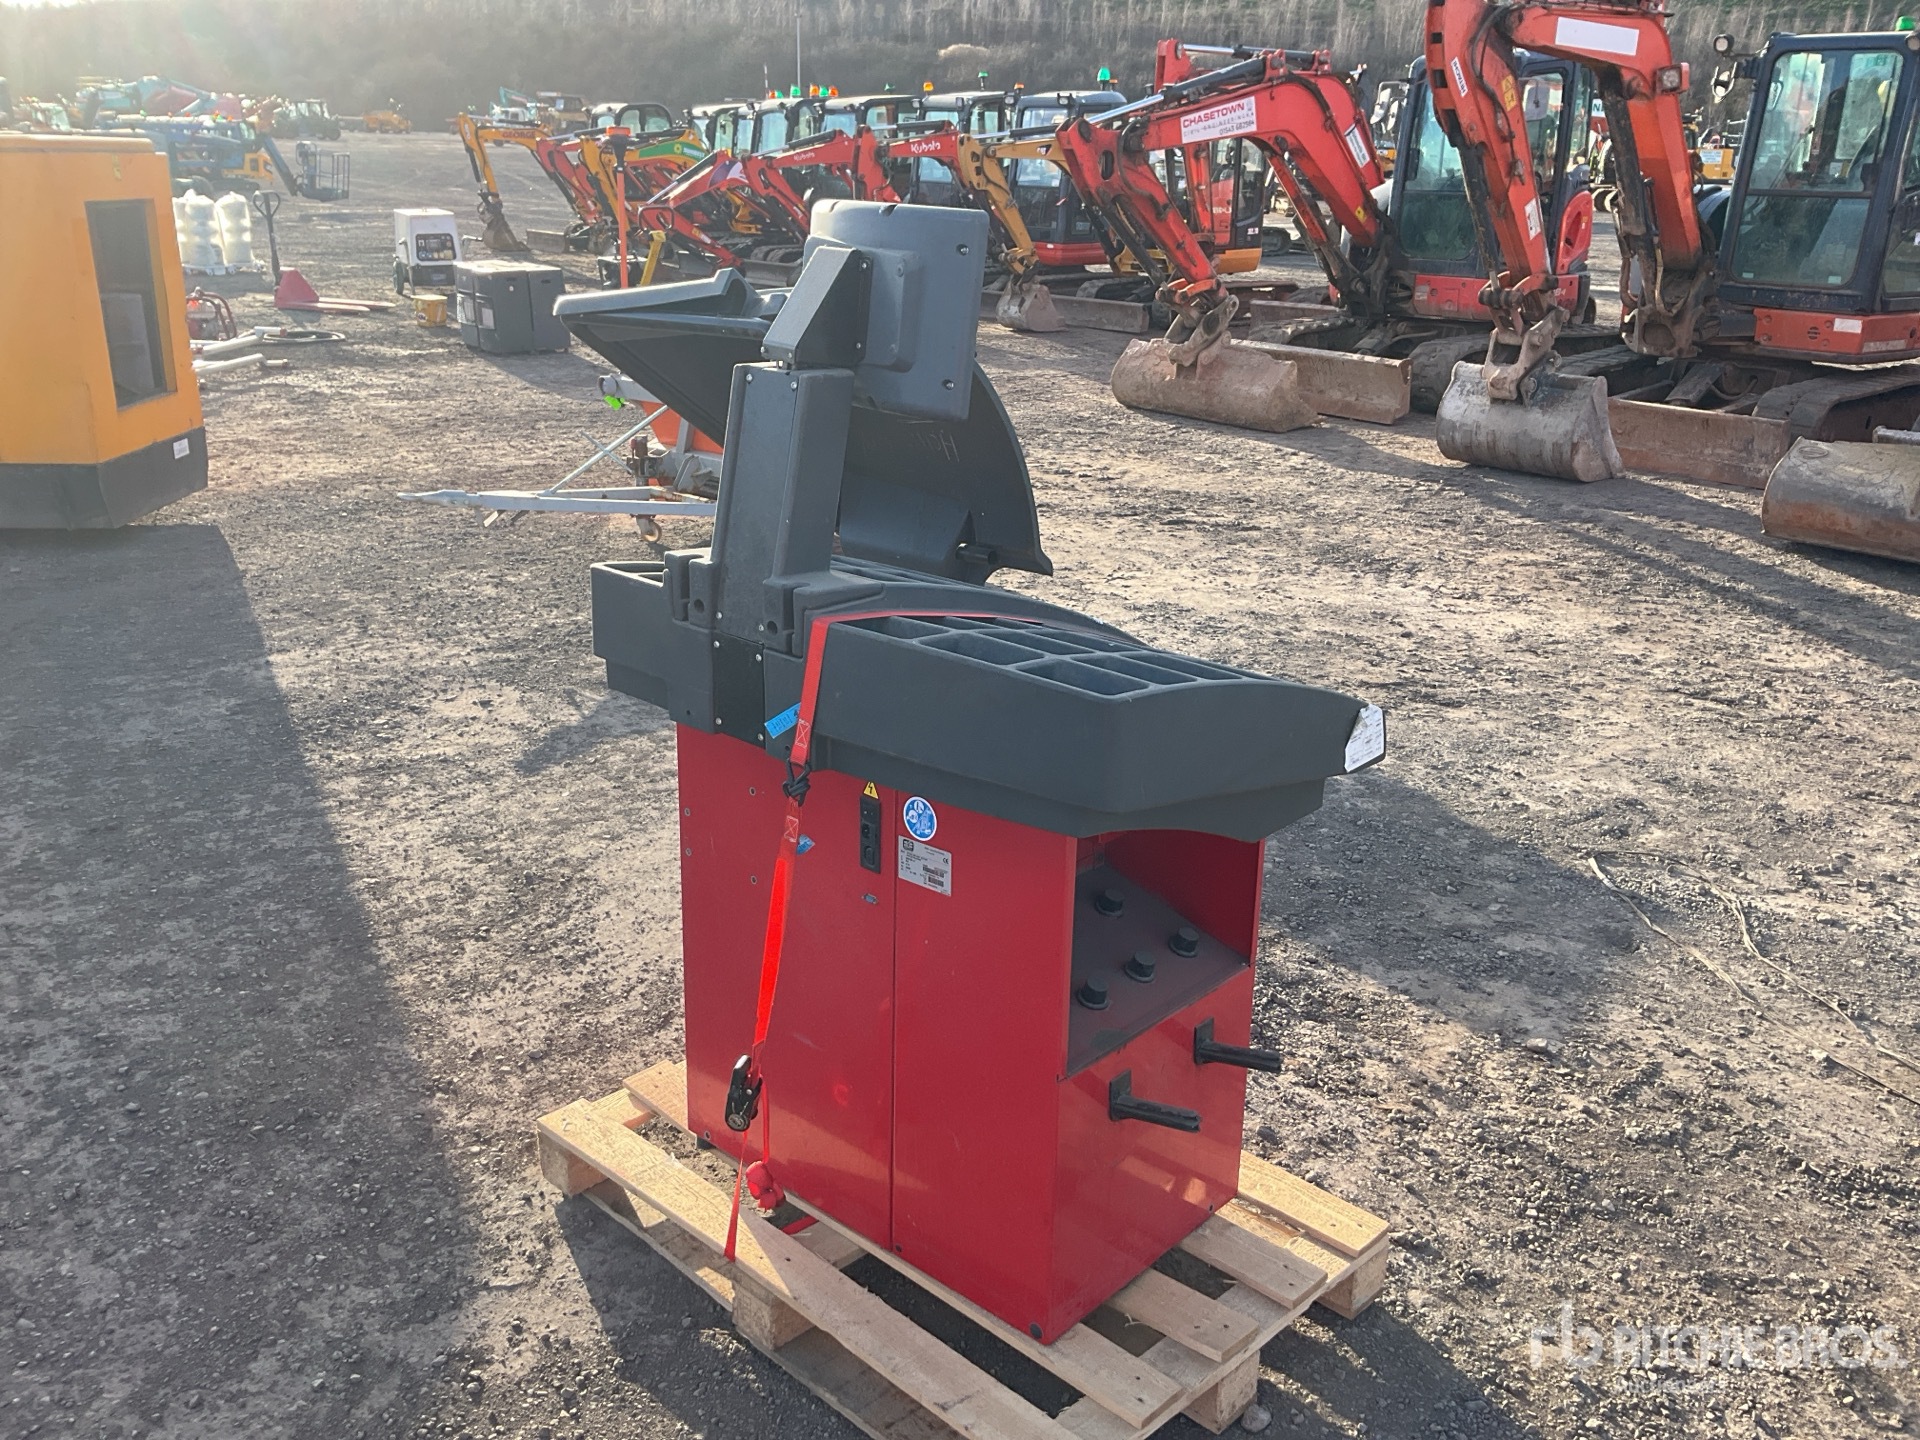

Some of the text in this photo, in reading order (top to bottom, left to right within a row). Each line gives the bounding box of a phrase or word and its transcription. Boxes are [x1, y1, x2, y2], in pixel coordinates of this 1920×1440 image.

[1453, 60, 1466, 94] HITACHI
[1182, 103, 1245, 128] CHASETOWN
[911, 140, 941, 153] Kubota
